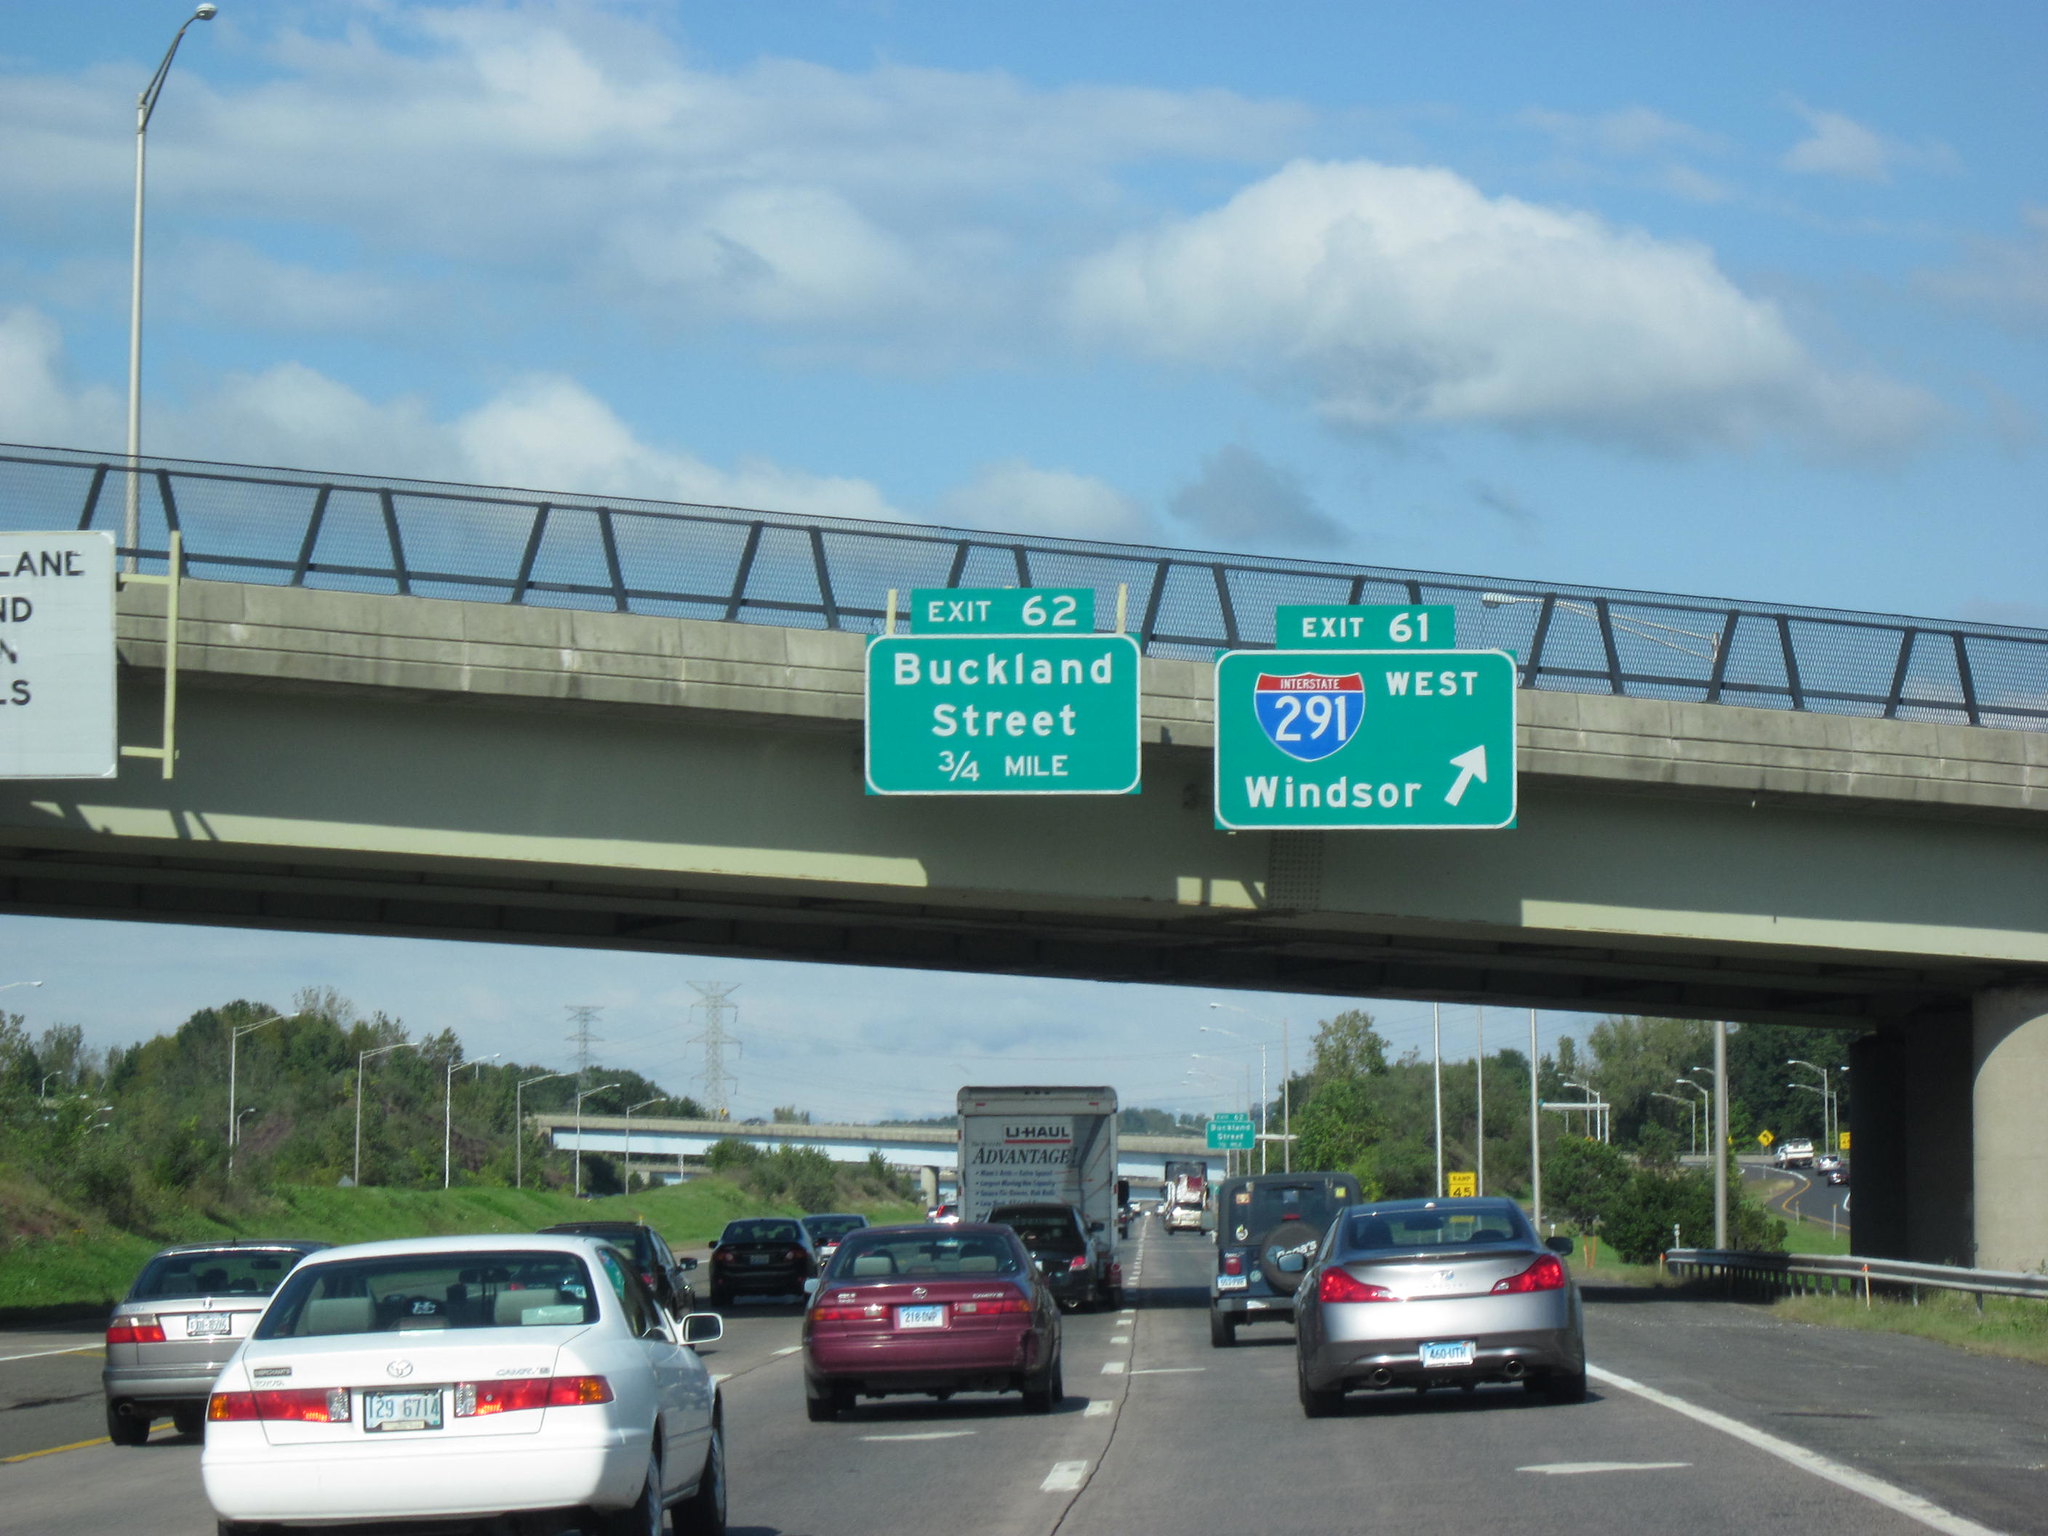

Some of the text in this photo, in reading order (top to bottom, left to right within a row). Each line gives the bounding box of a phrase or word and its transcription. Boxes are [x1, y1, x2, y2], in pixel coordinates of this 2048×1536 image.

[0, 551, 84, 576] ANE
[928, 595, 1077, 626] EXIT 62
[1302, 612, 1429, 642] EXIT 61
[894, 652, 1112, 685] Buckland
[1280, 678, 1340, 690] INTERSTATE
[1386, 671, 1478, 696] WEST
[932, 703, 1076, 736] Street
[1275, 695, 1347, 741] 291
[1005, 755, 1069, 776] MILE
[1245, 776, 1422, 808] Windsor
[1005, 1126, 1071, 1138] U-HAUL
[1453, 1186, 1472, 1197] 45
